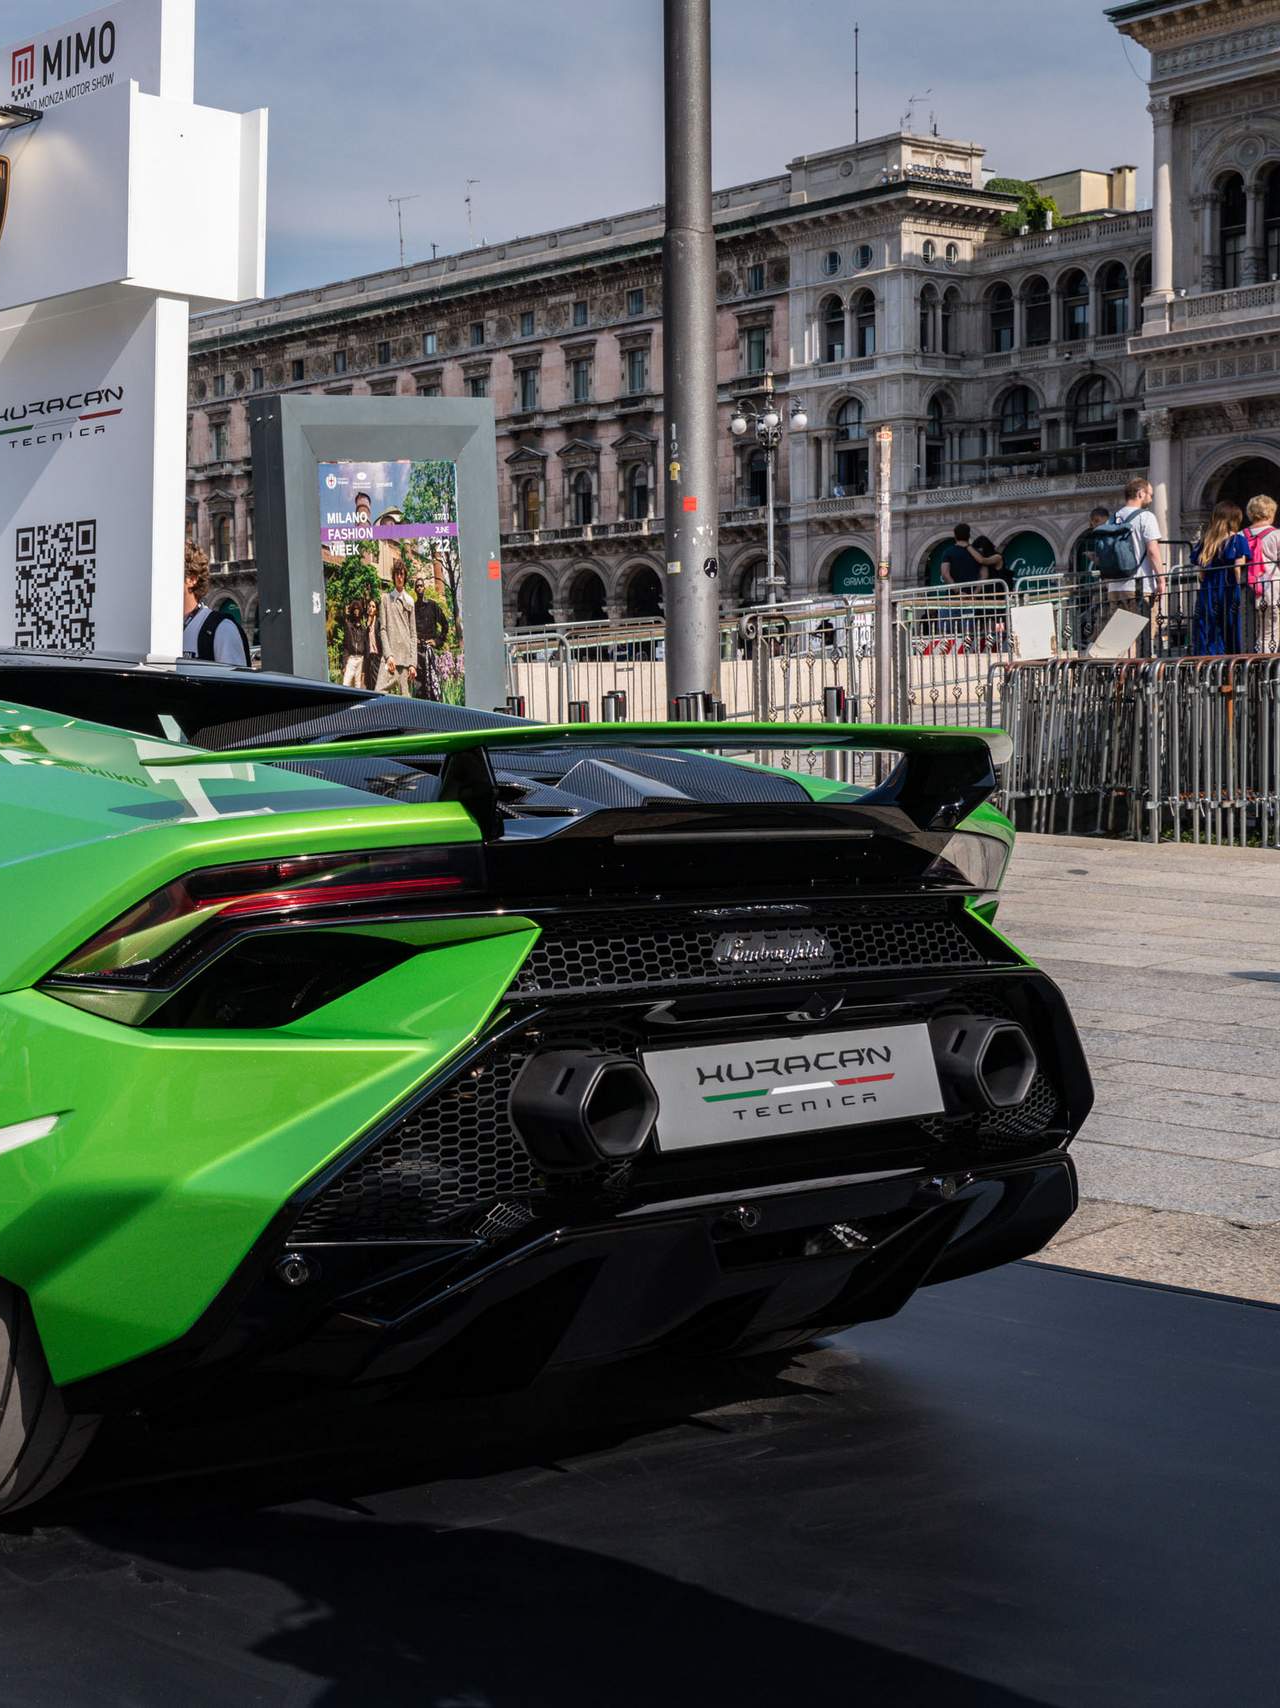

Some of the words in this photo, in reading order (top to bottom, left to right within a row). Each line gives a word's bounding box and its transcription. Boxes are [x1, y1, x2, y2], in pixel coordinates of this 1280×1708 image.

[43, 20, 115, 86] MIMO
[39, 90, 64, 109] MONZA
[65, 83, 91, 99] MOTOR
[92, 72, 115, 91] SHOW
[9, 425, 106, 449] TECNICA
[327, 511, 368, 524] MILANO
[328, 527, 374, 540] FASHION
[329, 543, 361, 557] WEEK
[436, 539, 451, 552] 22
[733, 1092, 877, 1120] TECNICA
